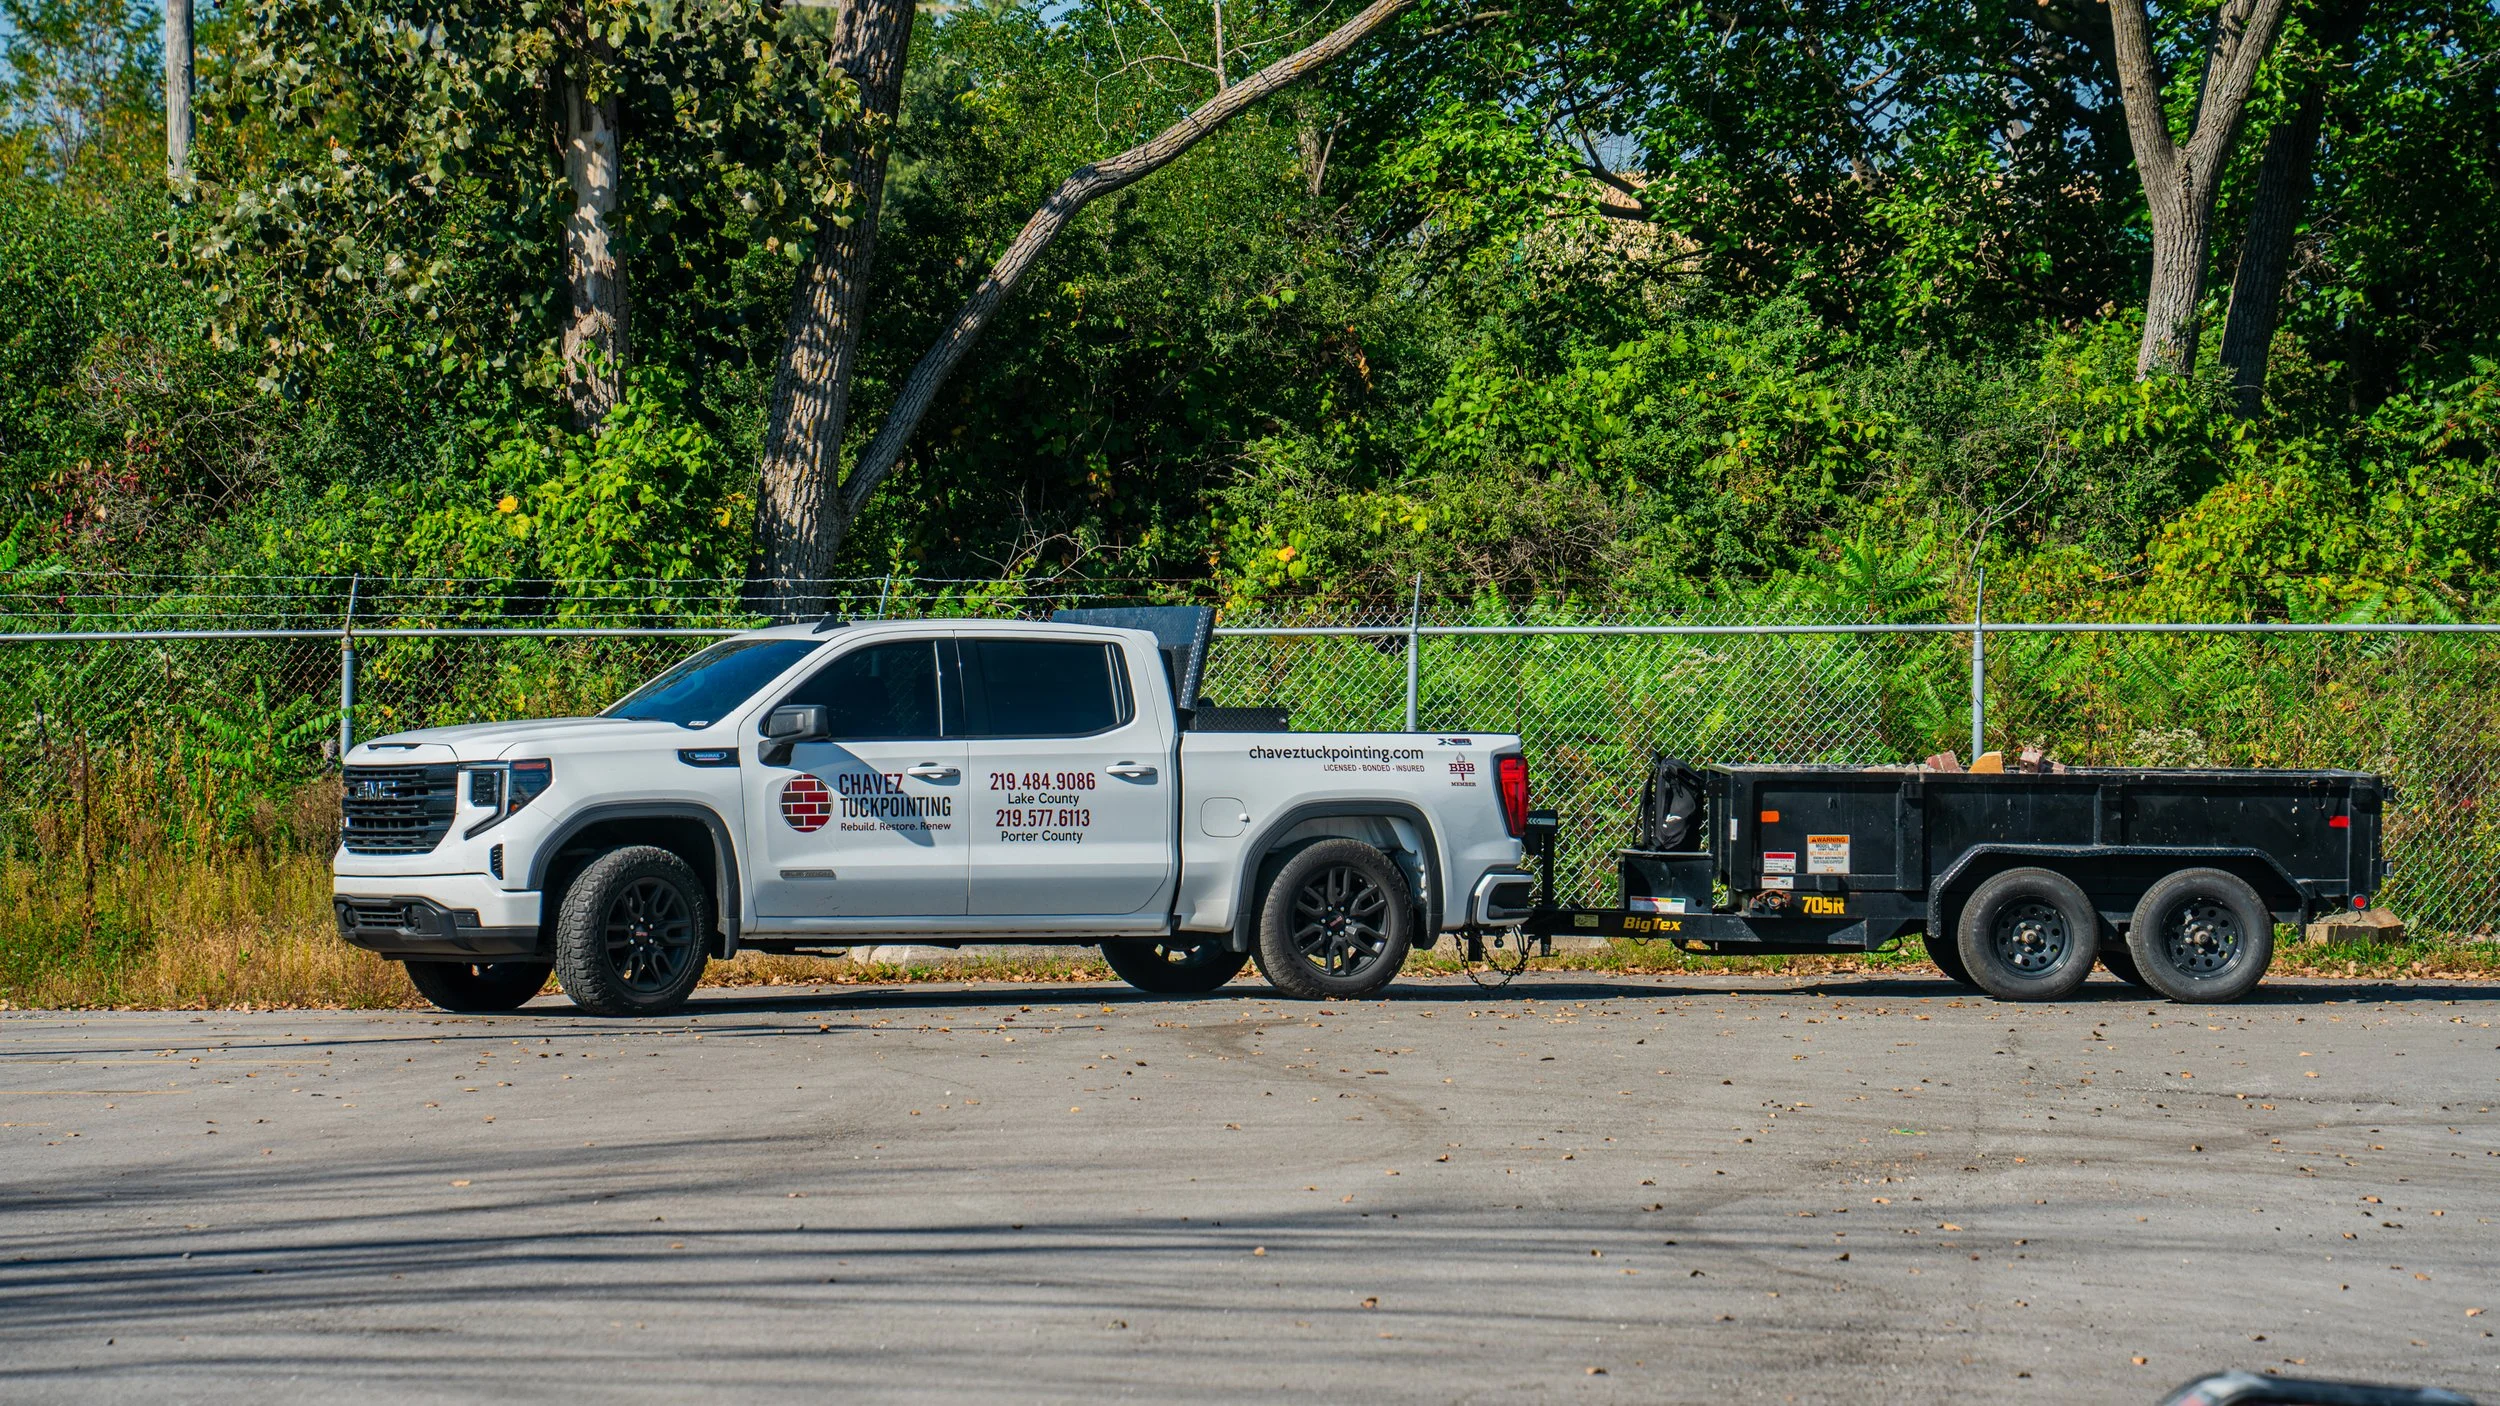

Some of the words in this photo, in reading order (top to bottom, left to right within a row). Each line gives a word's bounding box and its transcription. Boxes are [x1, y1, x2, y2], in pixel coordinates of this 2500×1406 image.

[1249, 745, 1424, 763] chaveztuckpointing.com
[1323, 764, 1357, 772] LICENSED
[1362, 764, 1390, 772] BONDED
[1396, 764, 1425, 772] INSURED
[1448, 763, 1475, 772] BBB
[839, 773, 903, 795] CHAVEZ
[990, 772, 1096, 791] 219.484.9086
[356, 781, 399, 801] GMC
[1008, 793, 1035, 804] Lake
[1038, 792, 1080, 807] County
[840, 797, 951, 817] TUCKPOINTING
[840, 822, 877, 832] Rebuild.
[879, 821, 918, 831] Restore.
[920, 821, 951, 831] Renew
[995, 808, 1090, 827] 219.577.6113
[1001, 831, 1038, 842] Porter
[1041, 830, 1083, 844] County
[1802, 896, 1845, 914] 70SR
[1623, 916, 1682, 933] BigTex
